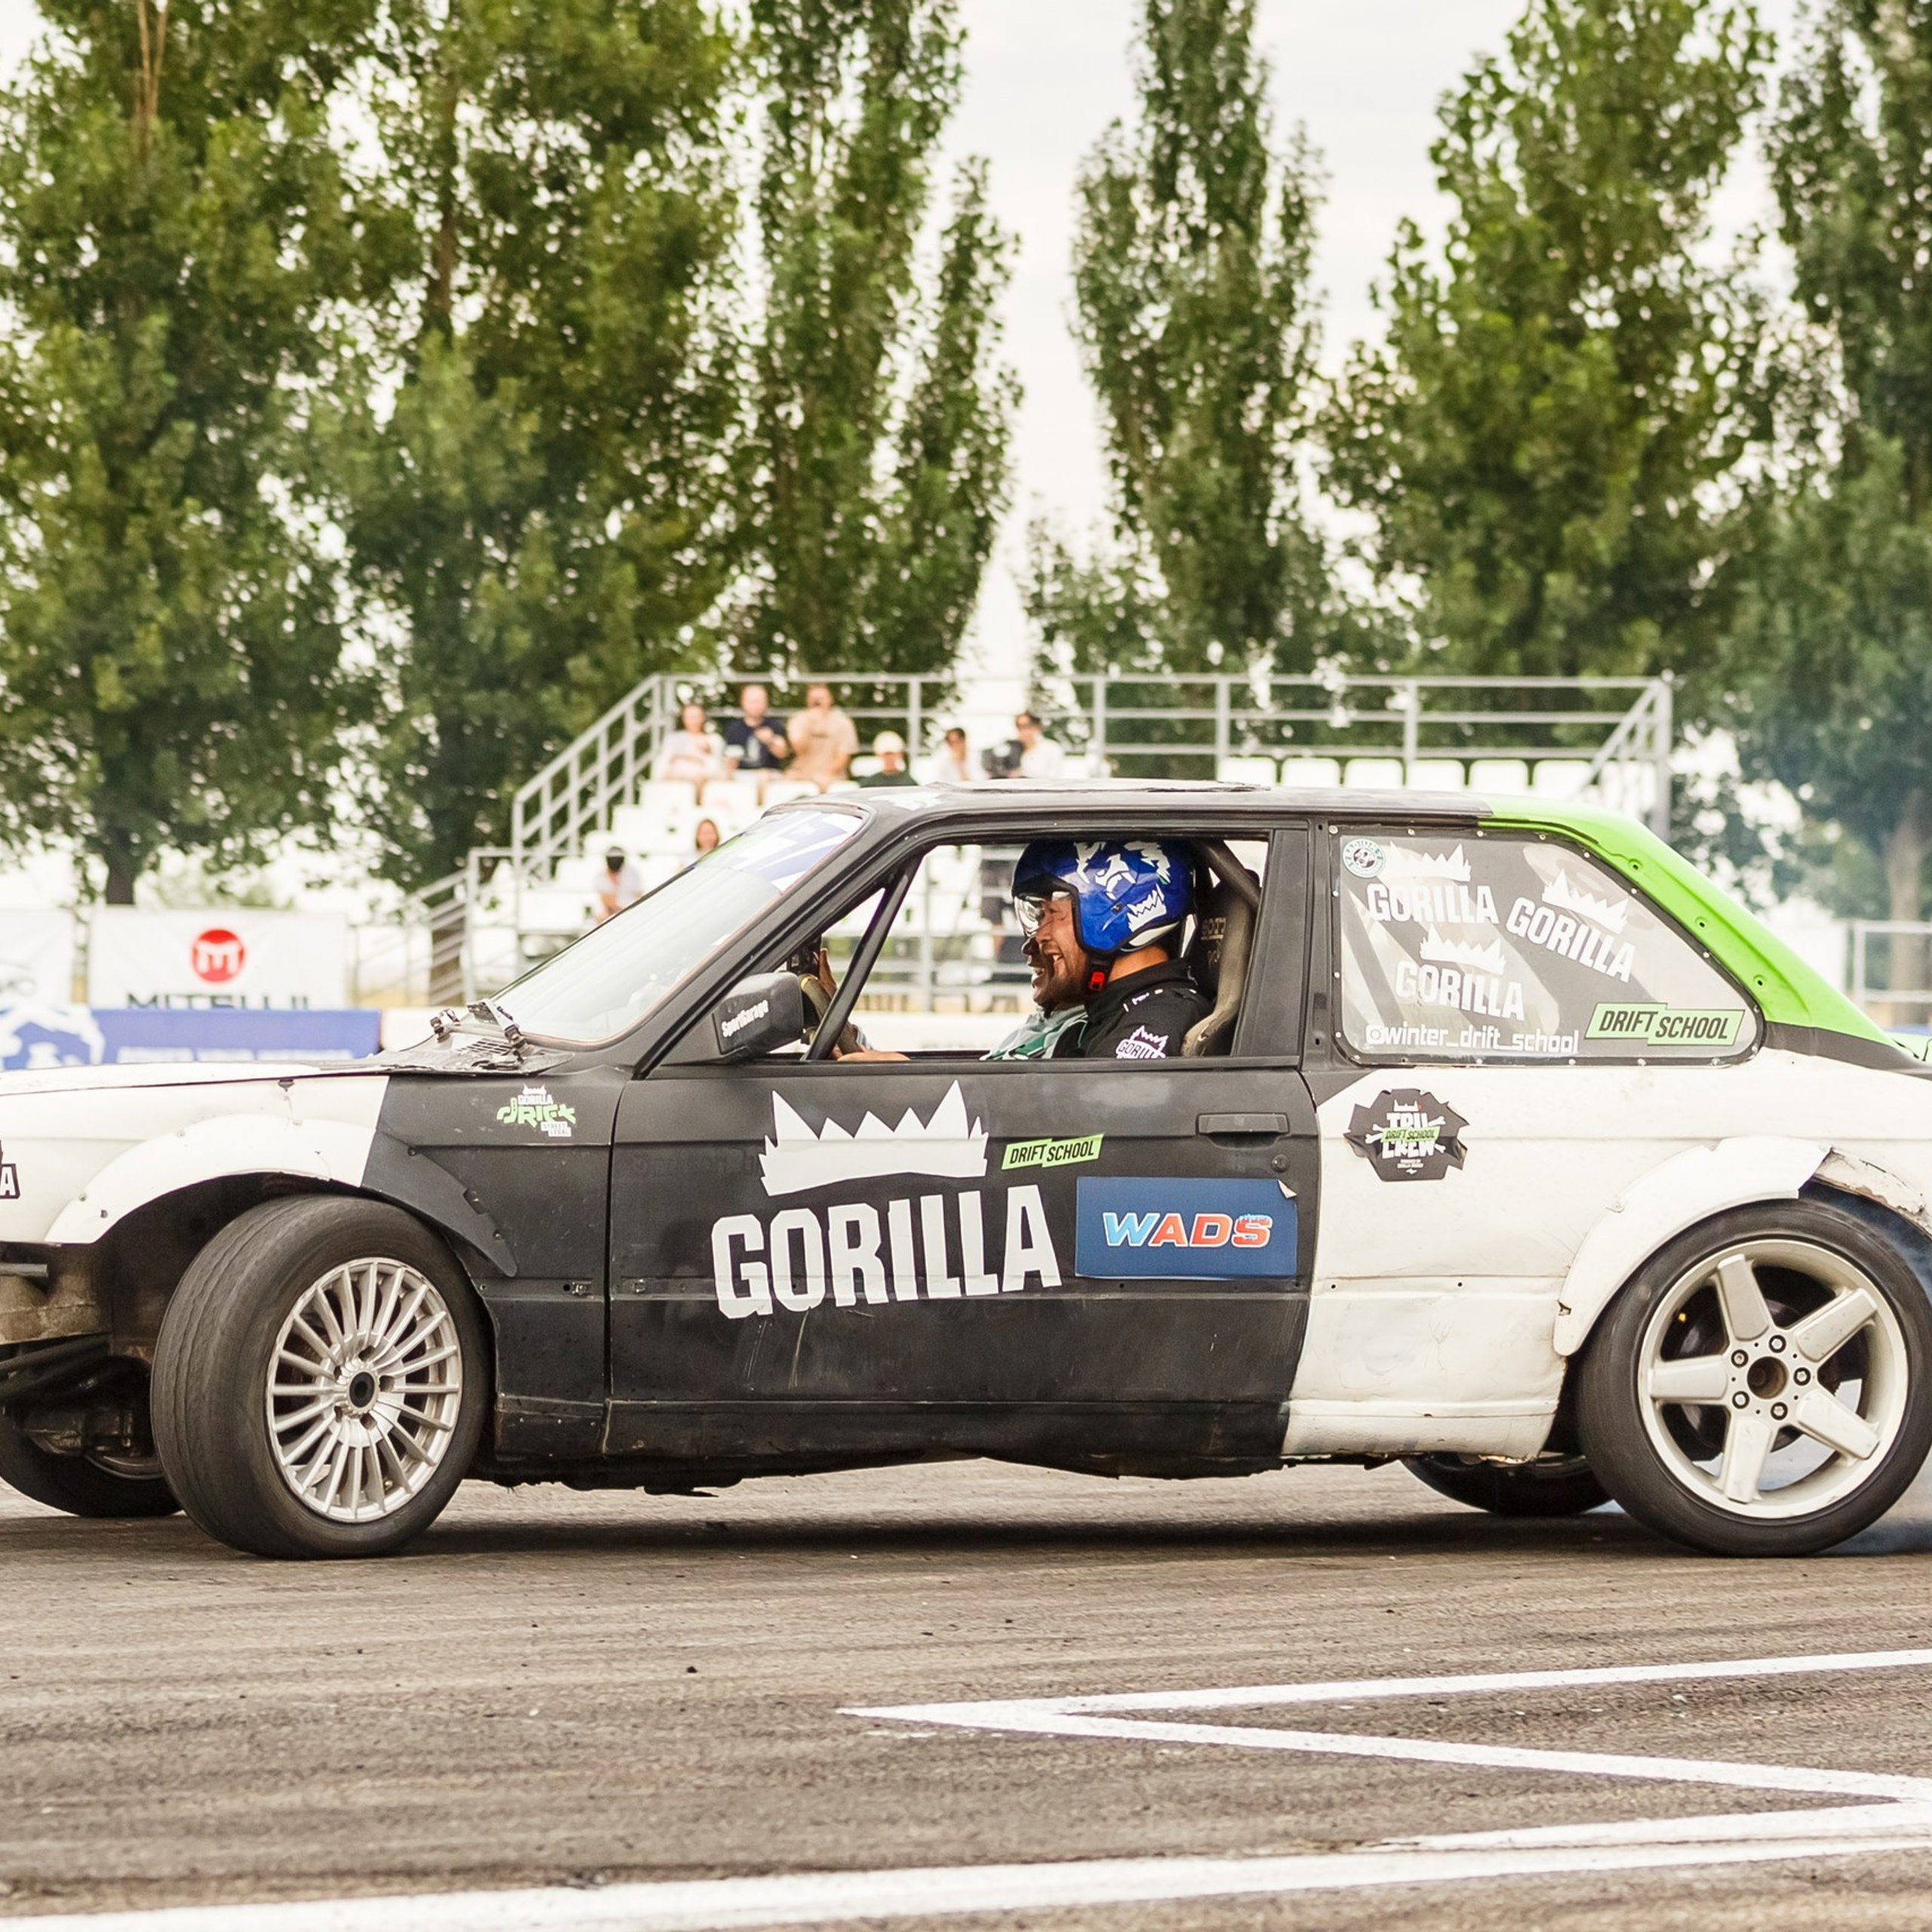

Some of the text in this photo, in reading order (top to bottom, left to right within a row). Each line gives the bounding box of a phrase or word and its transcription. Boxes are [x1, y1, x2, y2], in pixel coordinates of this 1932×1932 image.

[1367, 883, 1500, 924] GORILLA
[1506, 897, 1636, 983] GORILLA
[1395, 960, 1525, 1021] GORILLA
[1365, 1021, 1580, 1054] @winter_drift_school
[1598, 1010, 1729, 1039] DRIFT SCHOOL
[1009, 1140, 1094, 1164] DRIFT SCHOOL
[1386, 1129, 1435, 1140] DRIFT SCHOOL
[1102, 1211, 1273, 1248] WADS
[711, 1184, 1062, 1319] GORILLA
